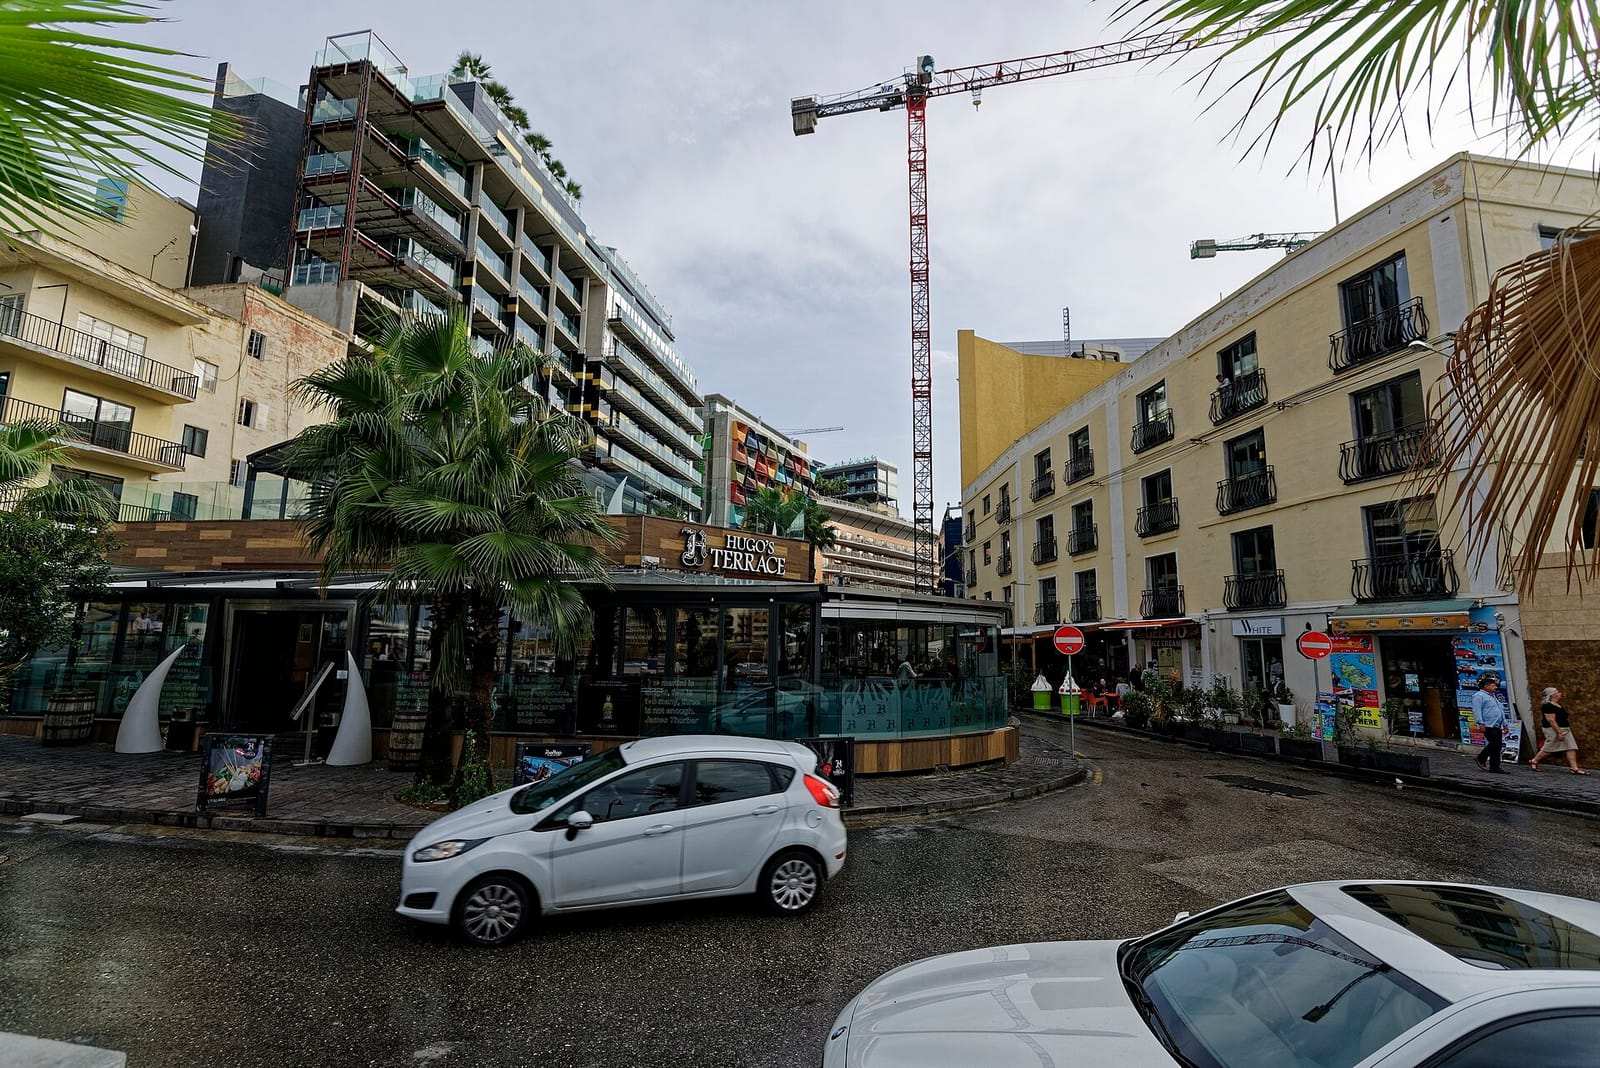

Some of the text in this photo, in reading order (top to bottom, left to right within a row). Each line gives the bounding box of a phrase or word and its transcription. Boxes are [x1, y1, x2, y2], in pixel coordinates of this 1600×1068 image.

[726, 535, 775, 555] HUGO'S
[710, 548, 786, 576] TERRACE
[1358, 718, 1379, 727] HERE
